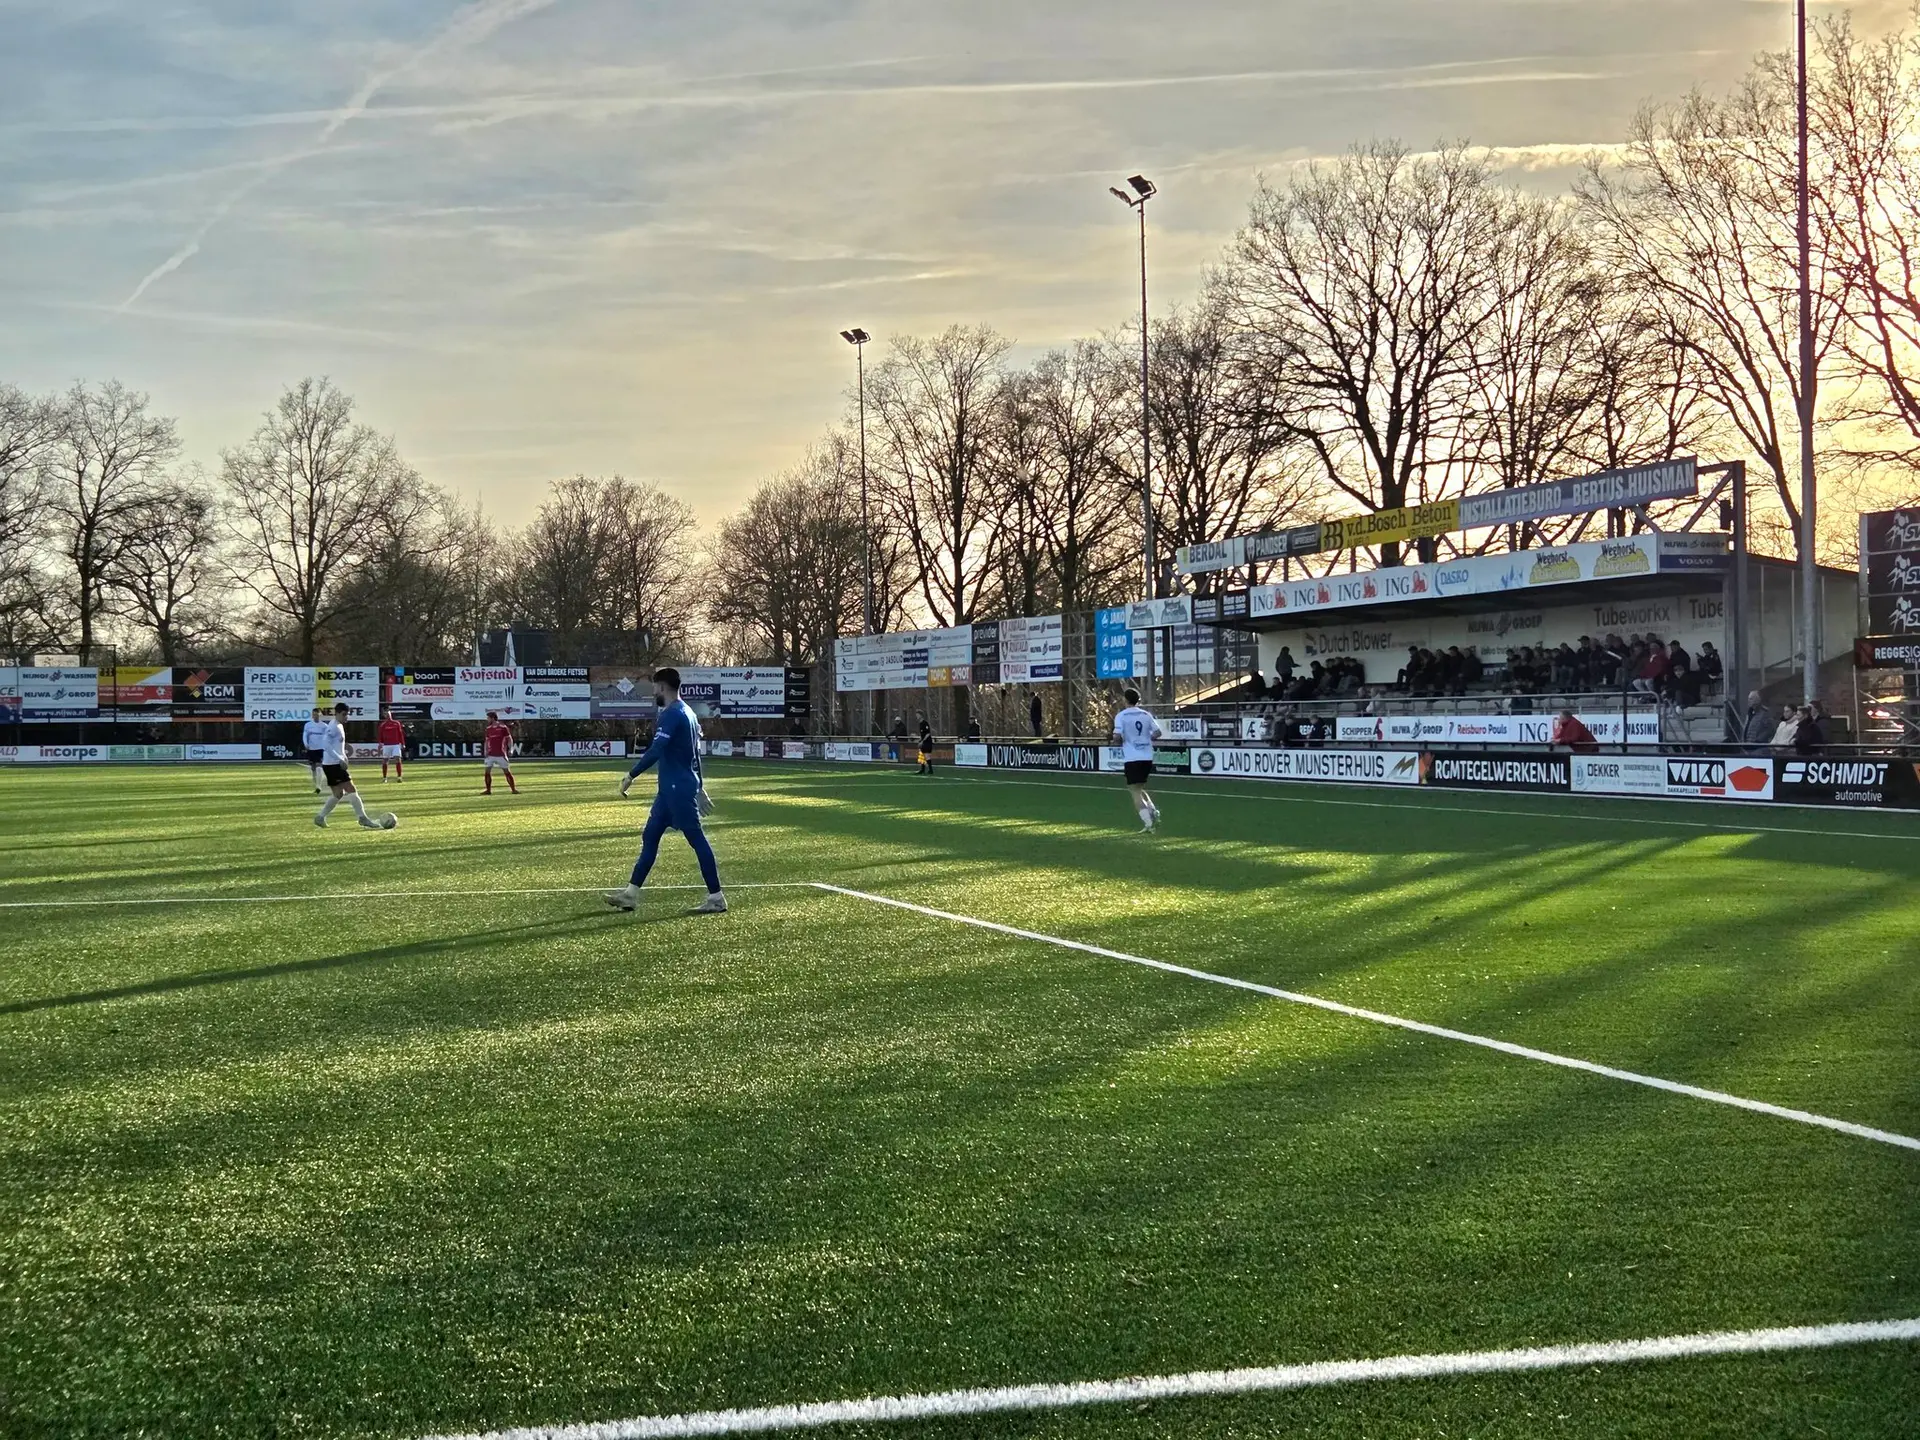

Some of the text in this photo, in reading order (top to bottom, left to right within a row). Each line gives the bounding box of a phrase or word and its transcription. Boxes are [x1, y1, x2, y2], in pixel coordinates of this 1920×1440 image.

[1460, 463, 1695, 524] INSTALLATIEBURO BERTUS HUISMAN
[1190, 541, 1228, 563] BERDAL
[1601, 541, 1636, 557] Weghorst
[1536, 551, 1568, 566] Weghorst
[1678, 557, 1714, 566] VOLVO
[1440, 569, 1469, 585] DASKO
[1338, 583, 1361, 601] ING
[1386, 577, 1410, 596] ING
[1253, 591, 1273, 612] ING
[1294, 588, 1315, 607] ING
[1594, 602, 1670, 627] Tubeworkx
[1110, 634, 1127, 647] JAKO
[1319, 634, 1349, 654] Dutch
[1353, 631, 1392, 651] Blower
[1110, 658, 1128, 671] JAKO
[318, 671, 364, 680] NEXAFE
[204, 685, 235, 697] RGM
[318, 689, 364, 698] NEXAFE
[1135, 721, 1143, 736] 9
[1171, 719, 1198, 733] BERDAL
[1342, 727, 1372, 735] SCHIPPER
[1422, 725, 1443, 734] GROEP
[1457, 724, 1507, 735] Reisburo Pouls
[1519, 722, 1548, 742] ING
[40, 745, 98, 760] incorpe
[419, 743, 456, 757] DEN
[568, 741, 598, 750] TIJKA
[274, 750, 294, 759] style
[991, 745, 1094, 769] NOVON Schoonmaak NOVON
[1222, 751, 1250, 773] LAND
[1255, 753, 1291, 774] ROVER
[1295, 753, 1385, 778] MUNSTERHUIS
[1435, 759, 1568, 785] RGMTEGELWERKEN.NL
[1587, 763, 1619, 778] DEKKER
[1668, 762, 1724, 785] WIKO
[1807, 761, 1889, 785] SCHMIDT
[1835, 789, 1882, 802] automotive
